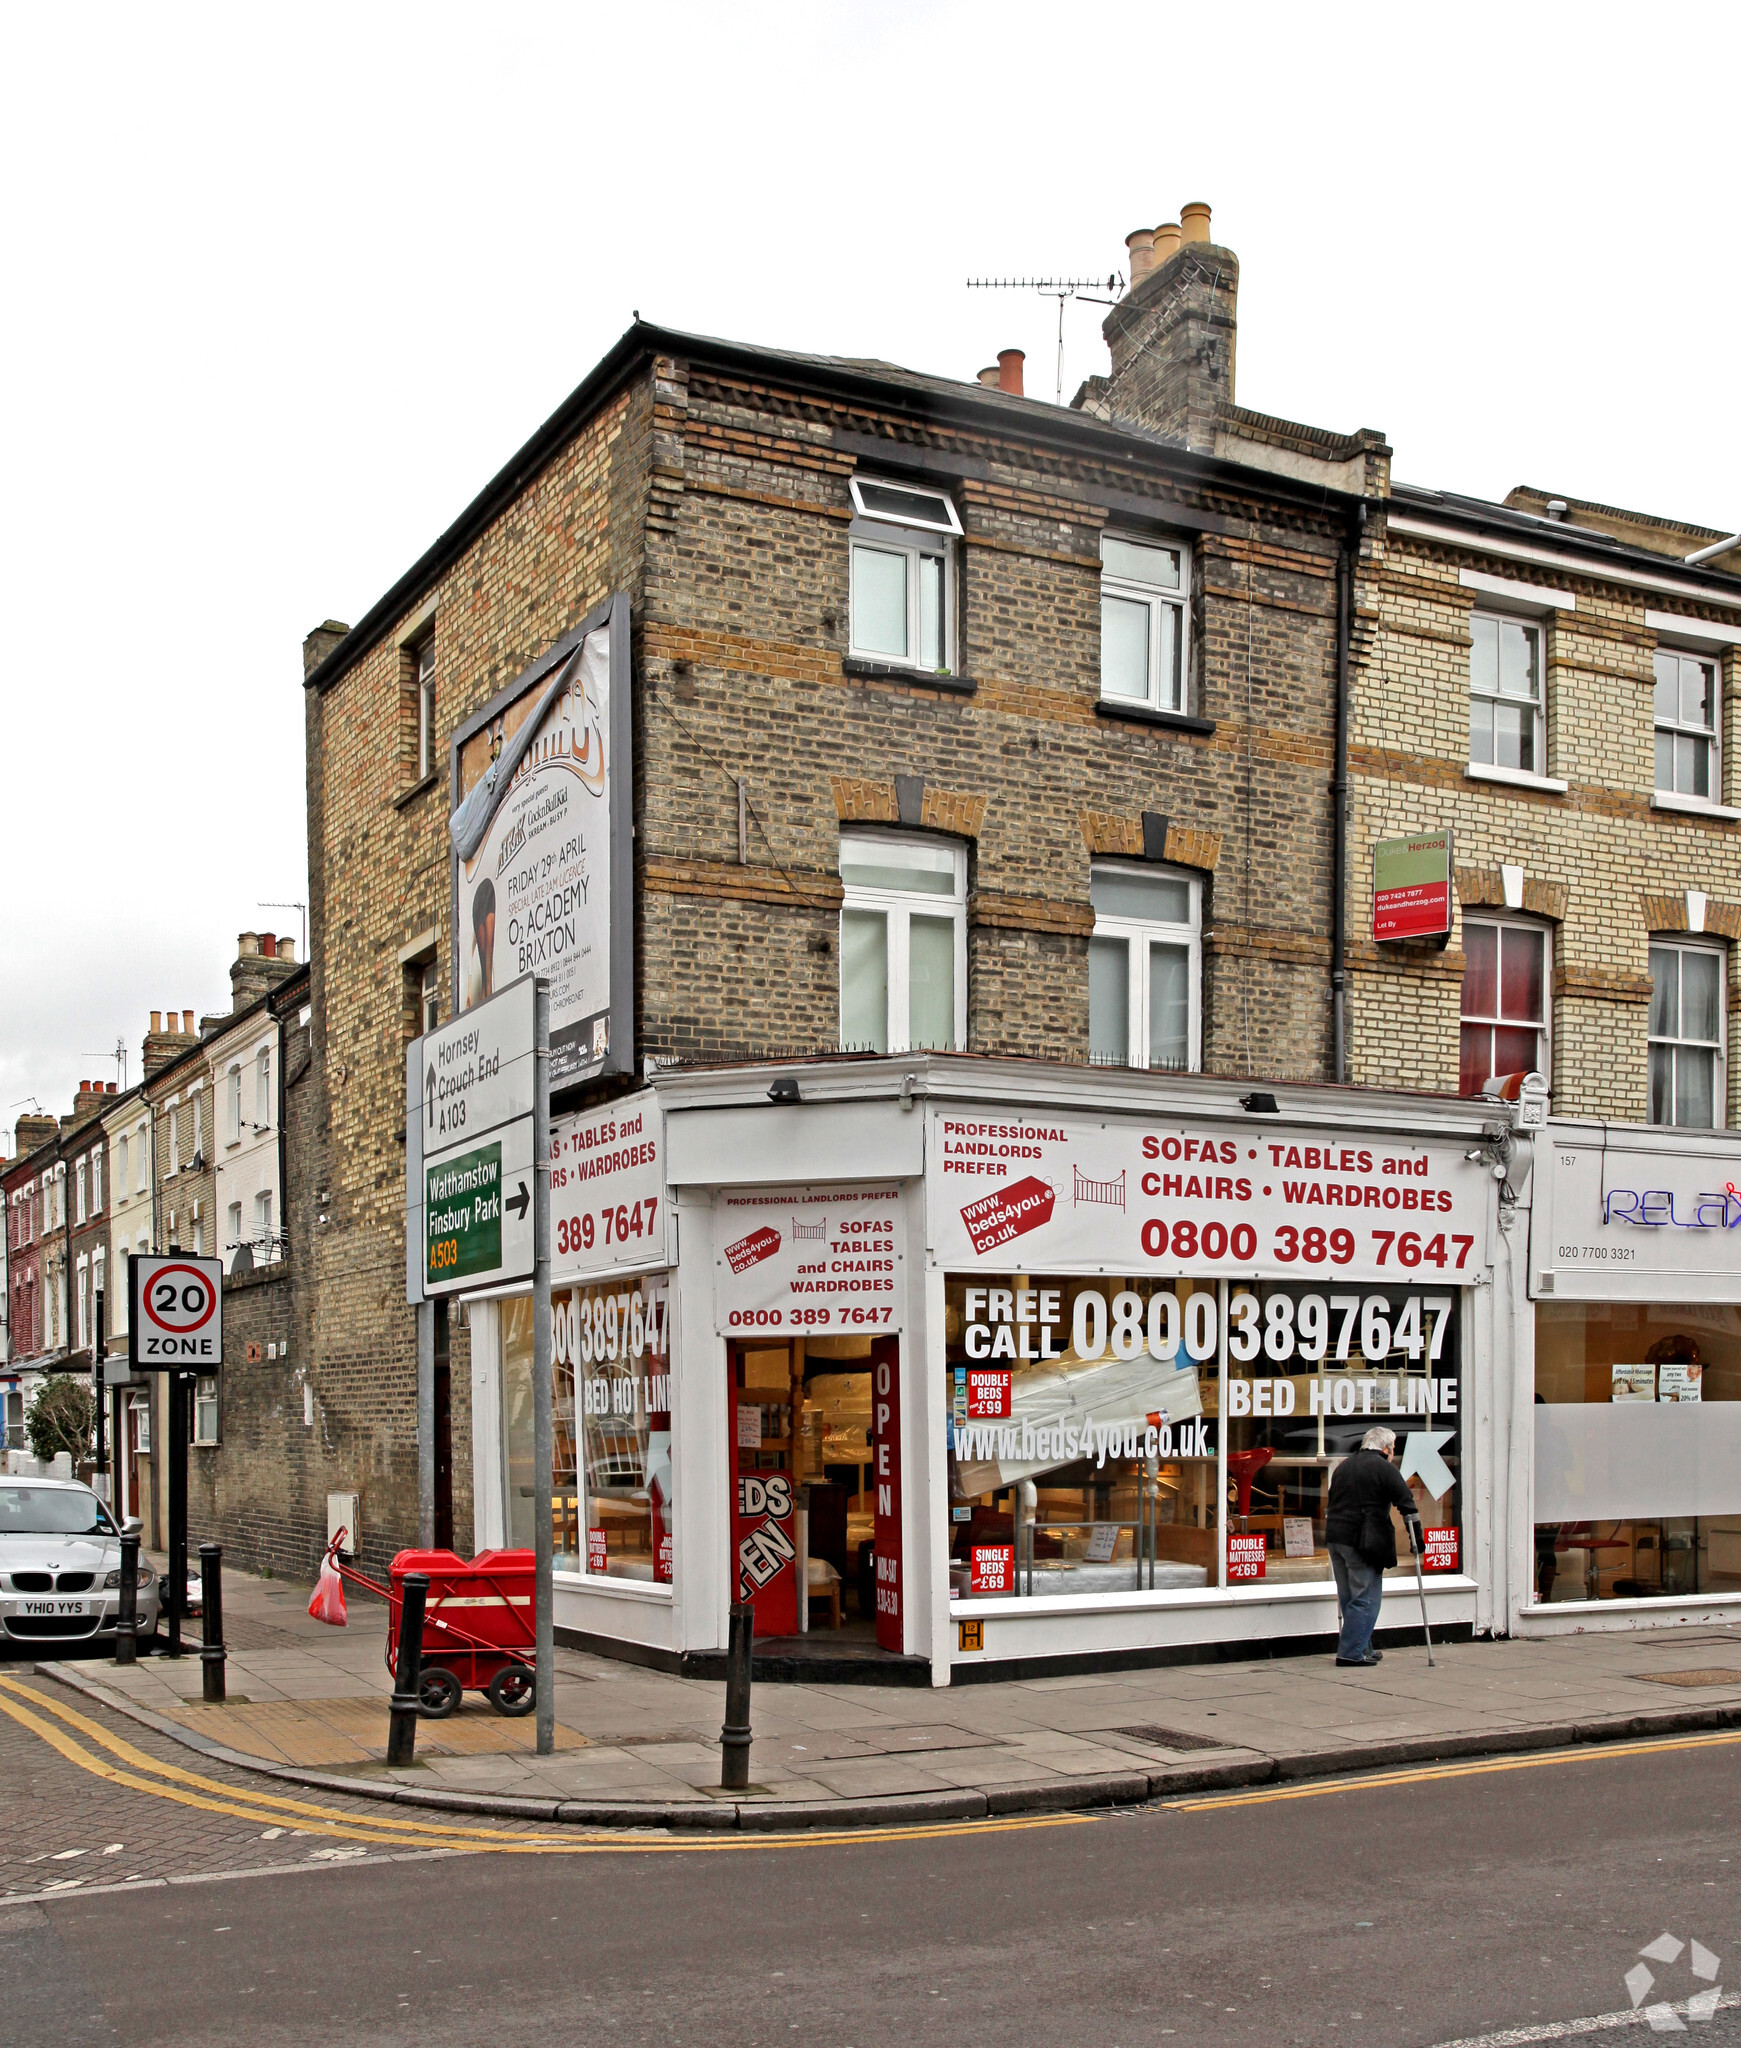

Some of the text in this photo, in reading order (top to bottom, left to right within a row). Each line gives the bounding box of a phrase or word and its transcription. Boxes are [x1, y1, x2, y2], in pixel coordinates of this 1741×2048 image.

[528, 821, 547, 840] SKREAM
[550, 810, 564, 826] BUSY
[508, 862, 539, 899] FRIDAY
[559, 834, 586, 868] APRIL
[508, 858, 586, 918] SPECIAL LATE 2AM LICENCE
[1377, 894, 1388, 902] 020
[1390, 892, 1406, 900] 7424
[527, 874, 590, 938] ACADEMY
[1377, 896, 1445, 912] dukeandherzog.com
[1388, 920, 1396, 928] By
[519, 918, 576, 974] BRIXTON
[439, 1028, 480, 1068] Hornsey
[439, 1047, 499, 1100] Crouch End
[440, 1100, 466, 1135] A103
[572, 1121, 616, 1153] TABLES
[620, 1113, 643, 1139] and
[944, 1122, 1068, 1142] PROFESSIONAL
[944, 1141, 1042, 1159] LANDLORDS
[1142, 1135, 1428, 1177] SOFAS TABLES and
[578, 1141, 656, 1182] WARDROBES
[944, 1160, 1008, 1176] PREFER
[1560, 1156, 1576, 1166] 157
[430, 1161, 498, 1202] Walthamstow
[727, 1191, 898, 1206] PROFESSIONAL LANDLORDS PREFER
[1141, 1172, 1452, 1212] CHAIRS WARDROBES
[430, 1191, 500, 1236] Finsbury Park
[963, 1195, 1004, 1220] www.
[968, 1194, 1046, 1236] beds4you.
[558, 1196, 658, 1255] 389 7647
[840, 1220, 894, 1234] SOFAS
[725, 1238, 750, 1256] www.
[830, 1240, 894, 1254] TABLES
[976, 1223, 1018, 1252] co.uk
[1141, 1218, 1476, 1269] 0800 389 7647
[430, 1238, 458, 1270] A503
[729, 1236, 776, 1264] beds4you.
[1558, 1246, 1636, 1260] 020 7700 3321
[733, 1255, 758, 1274] co.uk
[797, 1260, 894, 1274] and CHAIRS
[790, 1279, 894, 1293] WARDROBES
[155, 1284, 206, 1312] 20
[966, 1288, 1061, 1323] FREE
[728, 1306, 893, 1326] 0800 389 7647
[1072, 1290, 1452, 1362] 0800 3897647
[147, 1338, 212, 1356] ZONE
[965, 1324, 1061, 1358] CALL
[971, 1374, 1008, 1386] DOUBLE
[584, 1378, 608, 1414] BED
[613, 1376, 640, 1414] HOT
[978, 1387, 1002, 1400] BEDS
[1229, 1379, 1296, 1416] BED
[1310, 1378, 1377, 1416] HOT
[1390, 1378, 1458, 1414] LINE
[977, 1400, 1002, 1414] £99
[877, 1362, 892, 1516] OPEN
[953, 1416, 1209, 1469] www.beds4you.co.uk
[590, 1531, 606, 1542] DOUBLE
[1231, 1538, 1264, 1550] DOUBLE
[1428, 1530, 1455, 1542] SINGLE
[976, 1549, 1009, 1562] SINGLE
[1230, 1550, 1265, 1563] MATTRESSES
[1425, 1542, 1458, 1554] MATTRESSES
[980, 1562, 1004, 1574] BEDS
[1236, 1563, 1258, 1576] £69
[1432, 1554, 1452, 1567] £39
[980, 1576, 1004, 1590] £69
[26, 1602, 82, 1614] YH10 YYS
[968, 1624, 976, 1632] 12
[970, 1638, 974, 1646] 3
